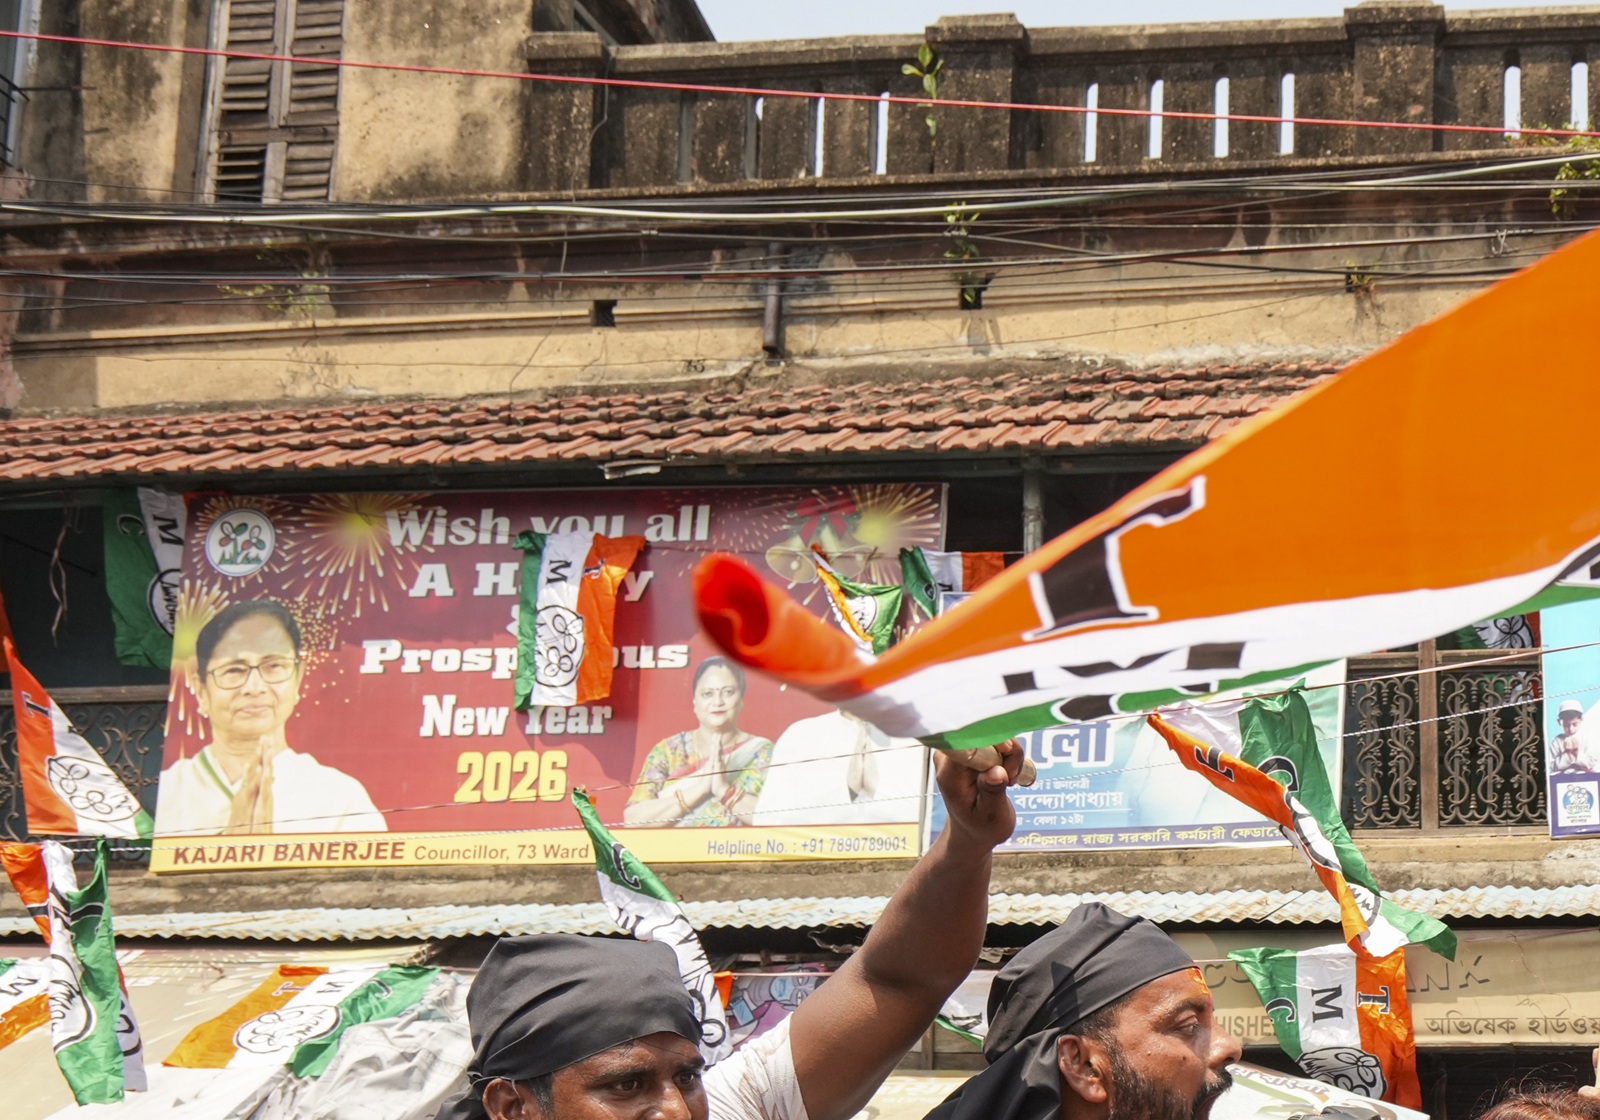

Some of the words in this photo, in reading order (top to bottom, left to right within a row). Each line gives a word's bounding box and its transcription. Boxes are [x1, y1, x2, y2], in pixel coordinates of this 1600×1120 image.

[385, 508, 511, 547] Wish
[645, 505, 711, 542] all
[409, 564, 453, 598] A
[546, 559, 573, 585] M
[360, 639, 689, 680] Prospus
[420, 695, 510, 738] New
[525, 704, 613, 736] Year
[454, 750, 568, 803] 2026
[707, 840, 762, 858] Helpline
[766, 839, 788, 854] No.
[801, 838, 825, 853] +91
[1016, 832, 1078, 847] পশ্চিমবঙ্গ
[1081, 833, 1114, 845] রাজ্য
[1118, 828, 1172, 843] সরকারি
[1175, 825, 1226, 841] কর্মচারী
[1231, 826, 1284, 839] ফেডারে
[173, 845, 265, 865] KAJARI
[273, 841, 406, 862] BANERJEE
[414, 845, 510, 862] Councillor,
[517, 844, 537, 859] 73
[543, 843, 590, 859] Ward
[1265, 997, 1297, 1024] C
[1311, 984, 1345, 1024] M
[1357, 986, 1391, 1015] T
[1214, 1015, 1277, 1038] HISHE
[1424, 1009, 1518, 1037] অভিষেক
